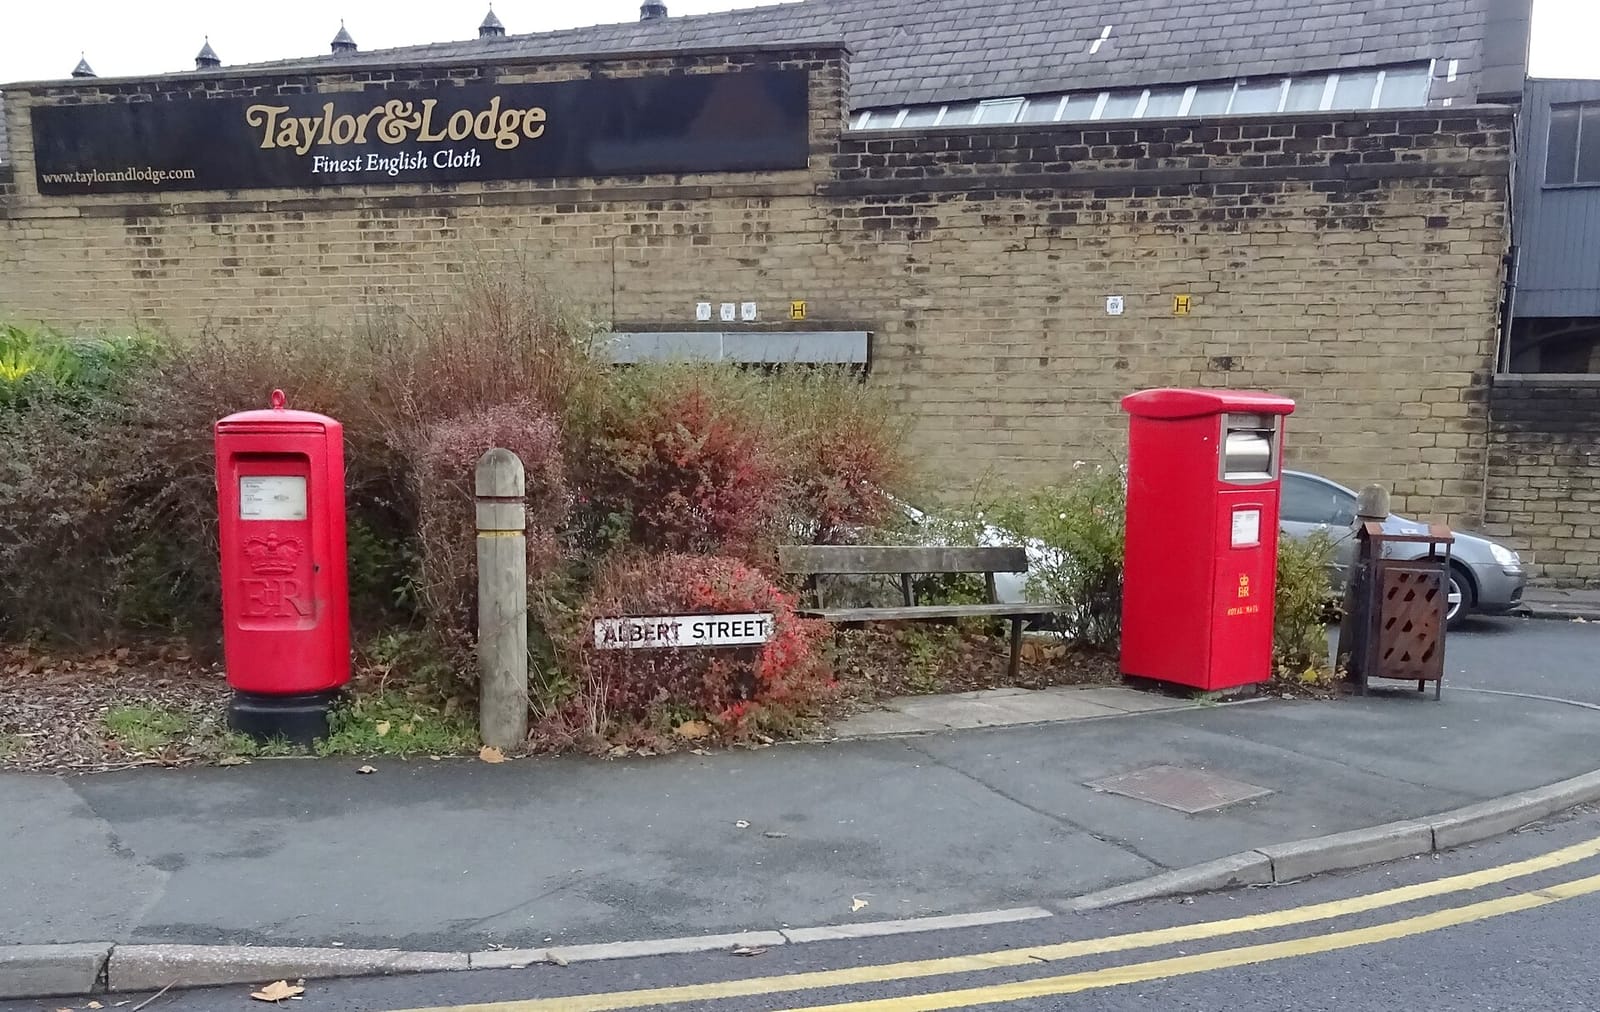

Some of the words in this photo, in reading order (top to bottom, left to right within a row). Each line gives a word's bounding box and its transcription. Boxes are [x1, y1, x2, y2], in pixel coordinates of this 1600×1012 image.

[312, 154, 362, 174] Finest
[366, 150, 428, 176] English
[433, 148, 482, 169] Cloth
[42, 167, 195, 186] www.taylorandlodge.com
[603, 623, 683, 643] ALBERT
[693, 621, 765, 638] STREET
